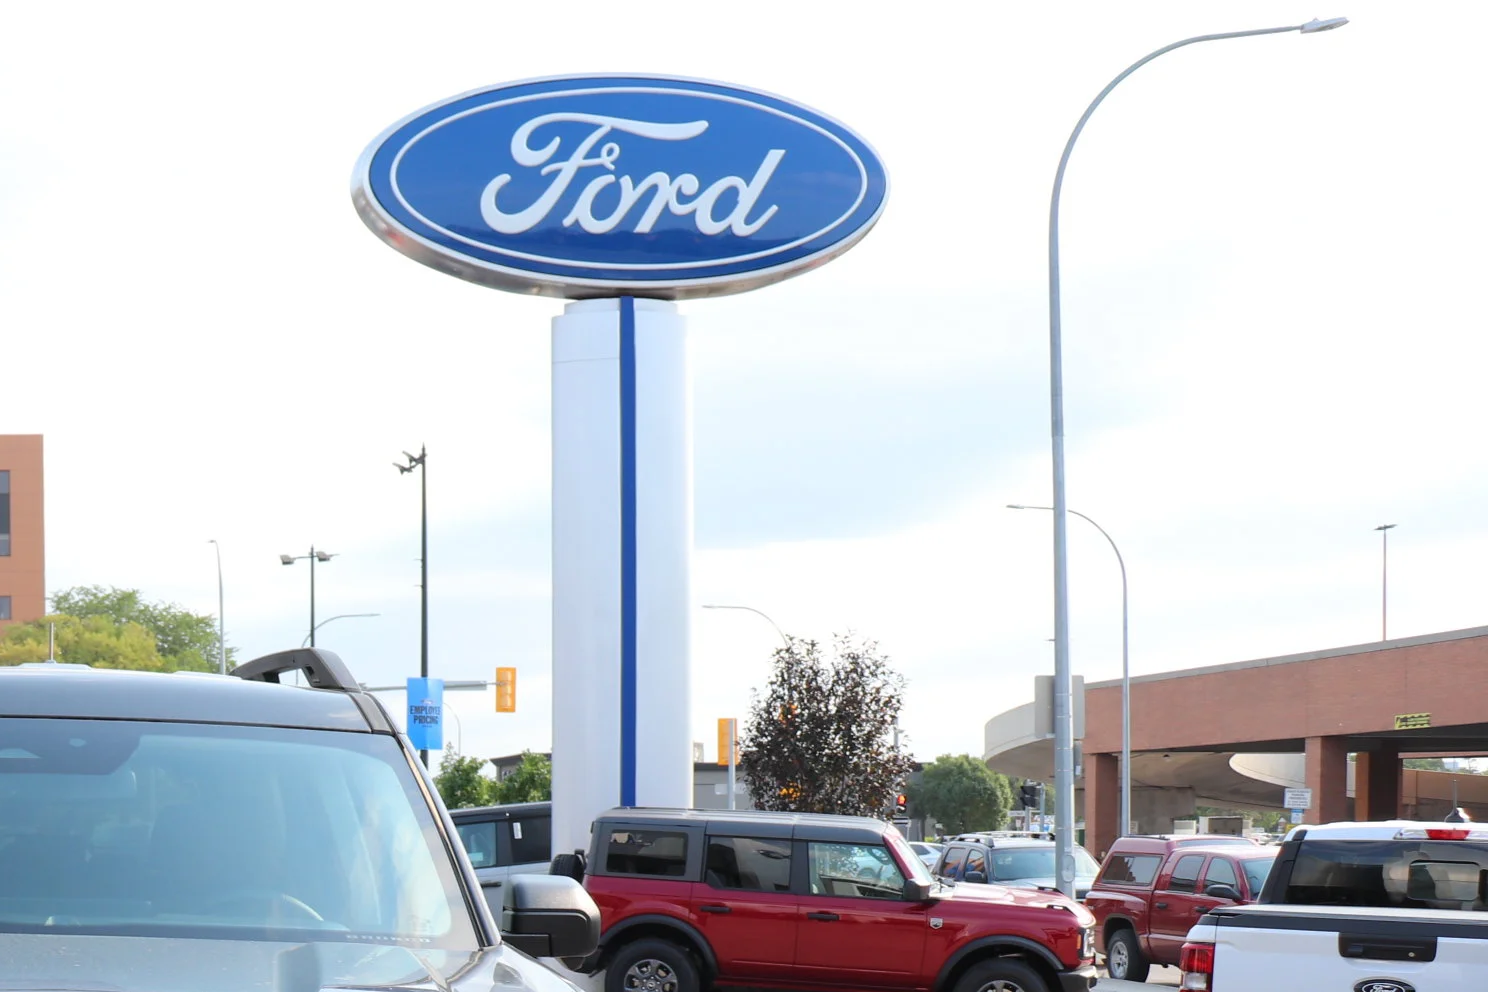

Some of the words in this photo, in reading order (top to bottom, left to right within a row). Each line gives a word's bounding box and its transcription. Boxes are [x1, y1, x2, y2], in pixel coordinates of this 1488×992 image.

[479, 112, 787, 237] Ford
[409, 705, 441, 715] EMPLOYEE
[413, 715, 438, 724] PRICING
